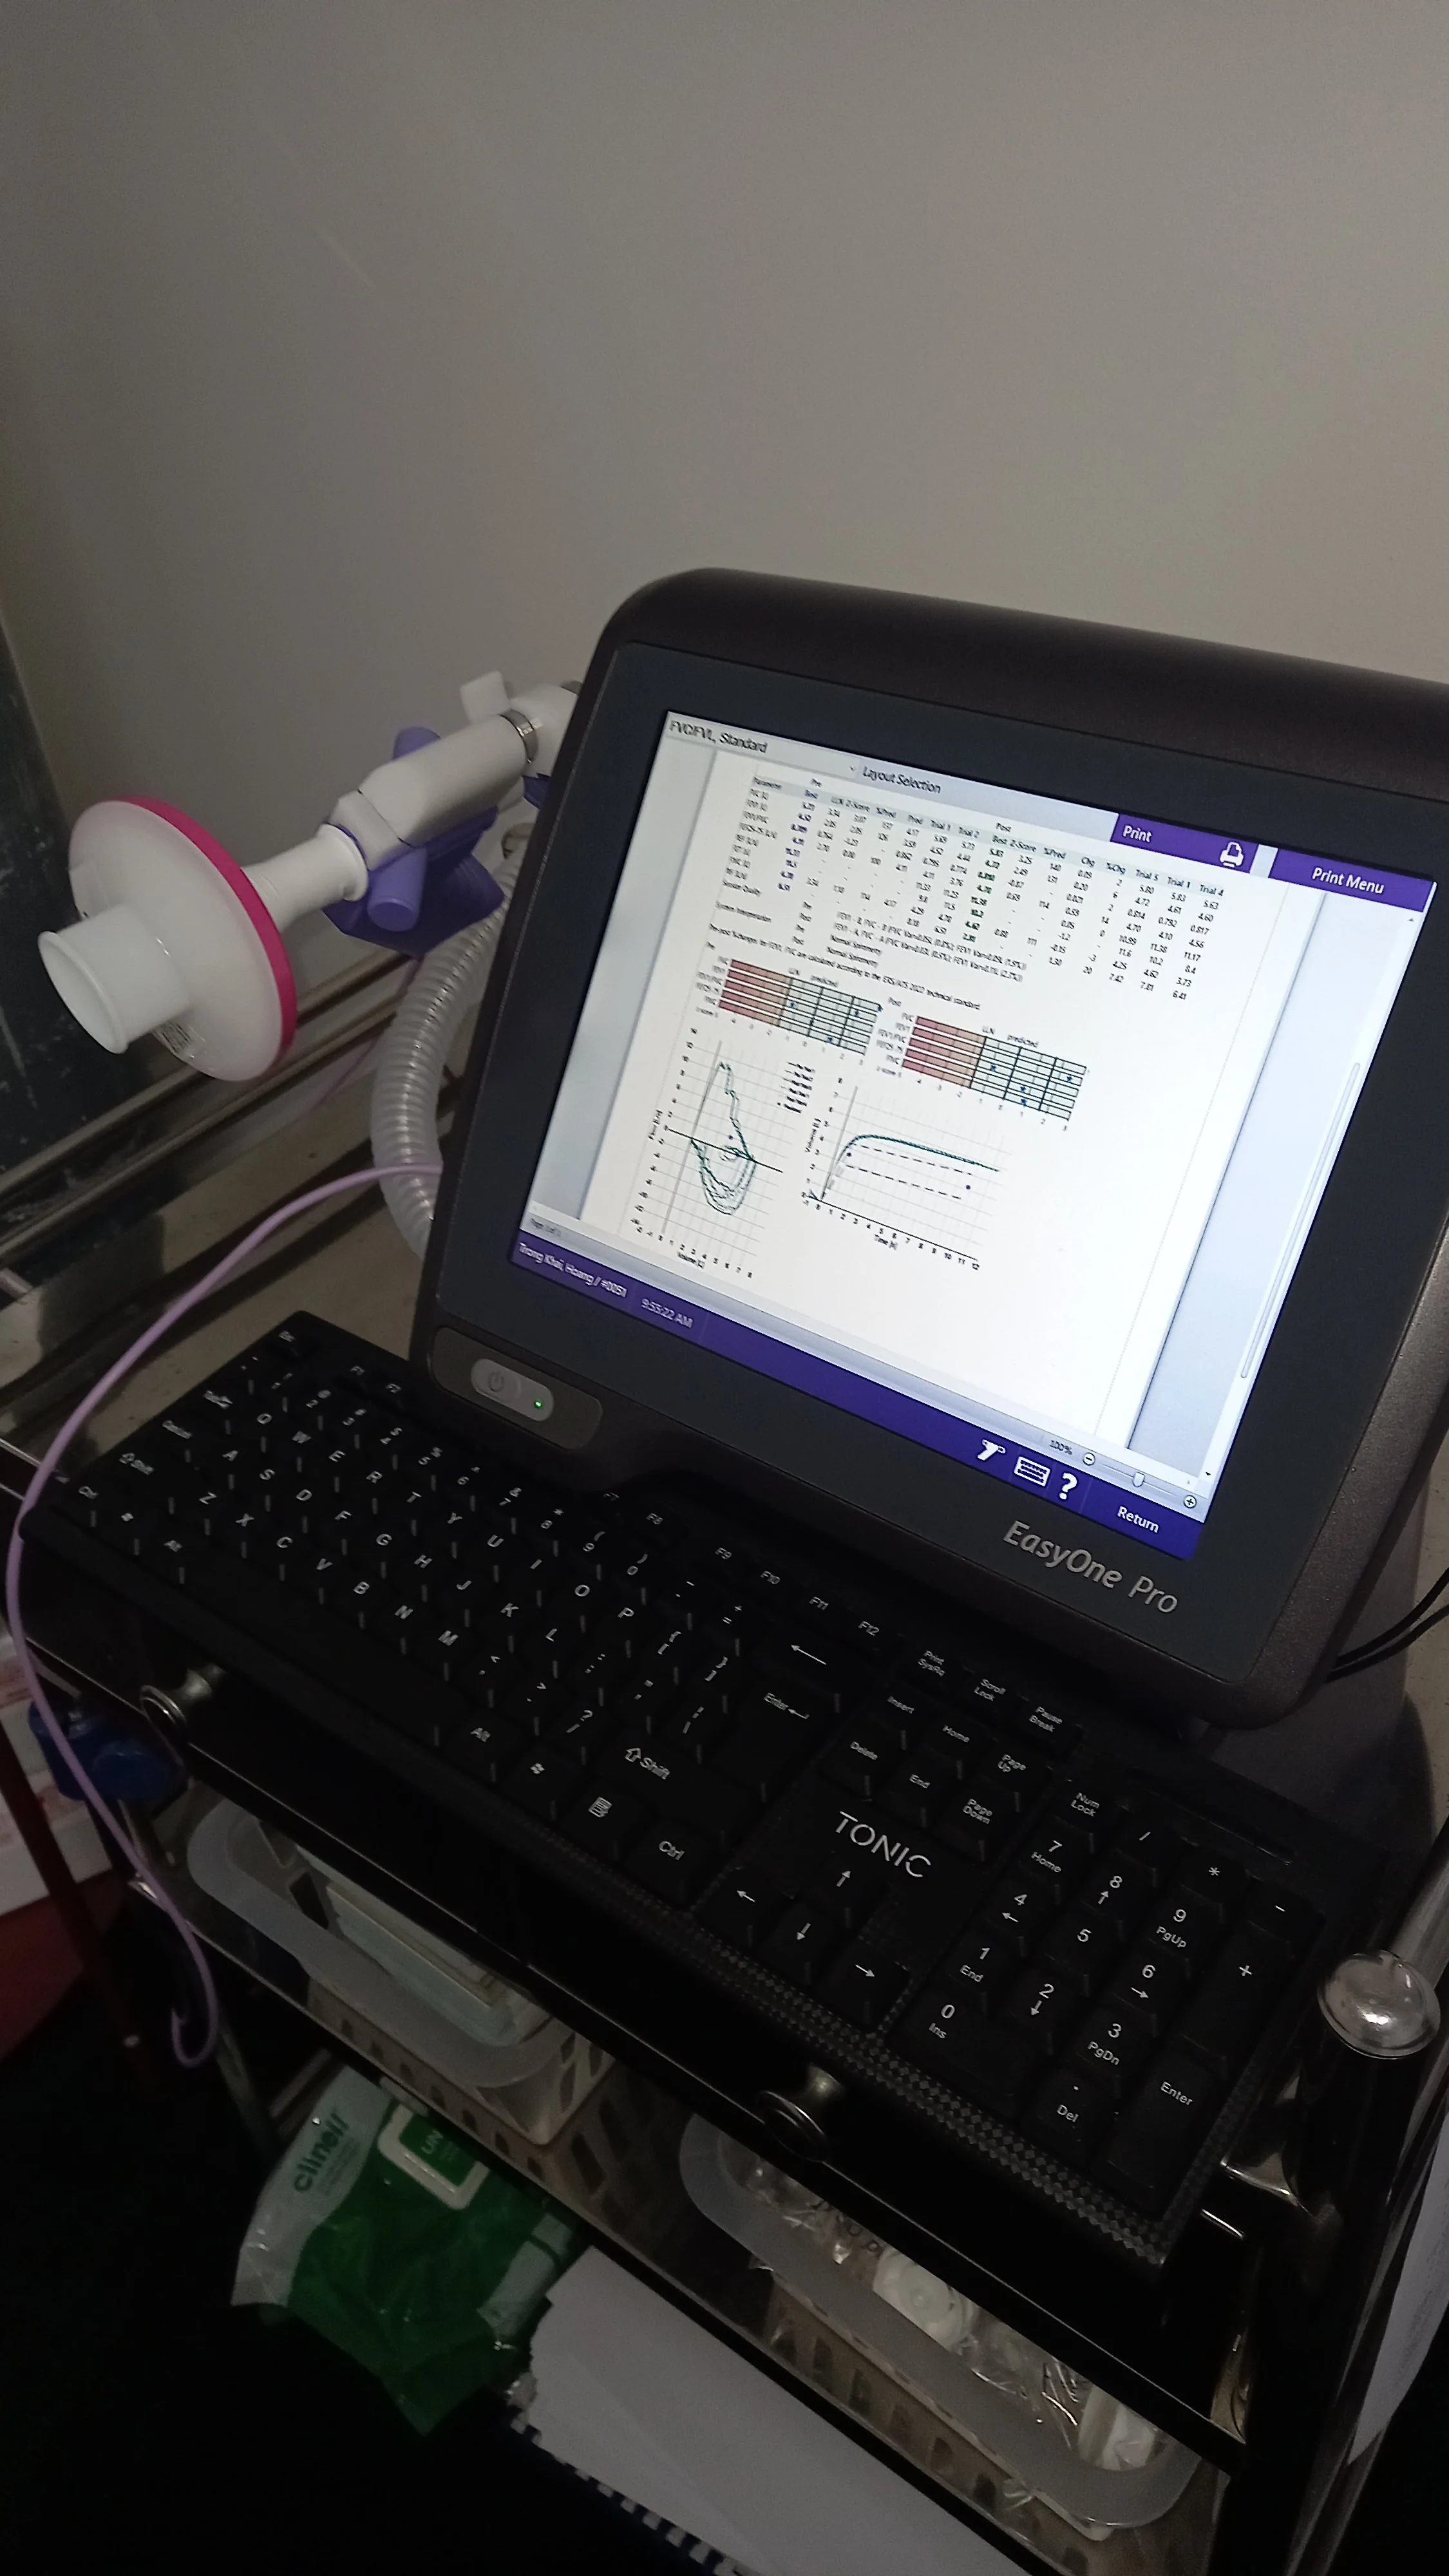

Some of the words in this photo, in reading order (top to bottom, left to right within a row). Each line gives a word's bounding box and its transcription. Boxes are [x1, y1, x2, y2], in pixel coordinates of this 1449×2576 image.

[719, 732, 768, 753] Standard
[862, 766, 896, 784] Layout
[896, 774, 941, 793] Selection
[1122, 825, 1152, 842] Print
[1136, 869, 1152, 880] Trial
[1168, 876, 1184, 887] Trial
[1200, 884, 1217, 895] Trial
[1312, 867, 1345, 886] Print
[1345, 875, 1385, 894] Menu
[674, 1313, 693, 1328] AM
[1049, 1439, 1073, 1455] 100%
[223, 1450, 238, 1461] A
[329, 1451, 345, 1462] E
[260, 1469, 274, 1480] S
[366, 1472, 382, 1483] R
[200, 1492, 216, 1504] Z
[296, 1490, 312, 1501] D
[408, 1492, 421, 1502] T
[236, 1513, 254, 1526] X
[335, 1511, 351, 1519] F
[448, 1513, 462, 1524] Y
[1117, 1506, 1159, 1533] Return
[541, 1520, 552, 1529] 8
[277, 1537, 292, 1548] C
[377, 1534, 392, 1546] G
[488, 1535, 504, 1547] U
[715, 1548, 732, 1559] F9
[317, 1558, 332, 1570] V
[415, 1555, 431, 1567] H
[1003, 1521, 1122, 1588] EasyOne
[1128, 1575, 1178, 1613] Pro
[354, 1582, 370, 1594] B
[457, 1580, 471, 1590] J
[501, 1603, 518, 1617] K
[810, 1596, 828, 1610] F11
[618, 1607, 634, 1618] P
[545, 1629, 557, 1642] L
[858, 1621, 879, 1636] F12
[974, 1686, 996, 1701] Lock
[887, 1696, 914, 1714] Insert
[1035, 1707, 1062, 1725] Pause
[1029, 1715, 1056, 1732] Break
[943, 1725, 969, 1742] Home
[851, 1741, 878, 1759] Delete
[641, 1757, 670, 1779] Shift
[998, 1760, 1012, 1772] Up
[1001, 1754, 1026, 1770] Page
[909, 1774, 930, 1788] End
[968, 1799, 992, 1817] Page
[1071, 1799, 1096, 1816] Lock
[1076, 1793, 1099, 1809] Num
[963, 1804, 990, 1824] Down
[836, 1812, 931, 1879] TONIC
[1049, 1841, 1062, 1852] 7
[1031, 1851, 1061, 1872] Home
[1110, 1876, 1122, 1888] 8
[1014, 1895, 1027, 1905] 4
[1173, 1909, 1186, 1922] 9
[1077, 1929, 1091, 1942] 5
[1157, 1926, 1186, 1947] PgUp
[980, 1948, 990, 1959] 1
[960, 1965, 983, 1982] End
[1142, 1965, 1155, 1978] 6
[1239, 1965, 1252, 1976] +
[1039, 1984, 1054, 1998] 2
[942, 2005, 954, 2018] 0
[929, 2023, 947, 2038] Ins
[1108, 2023, 1121, 2038] 3
[1088, 2041, 1119, 2065] PgDn
[1161, 2082, 1193, 2105] Enter
[1057, 2105, 1078, 2122] Del
